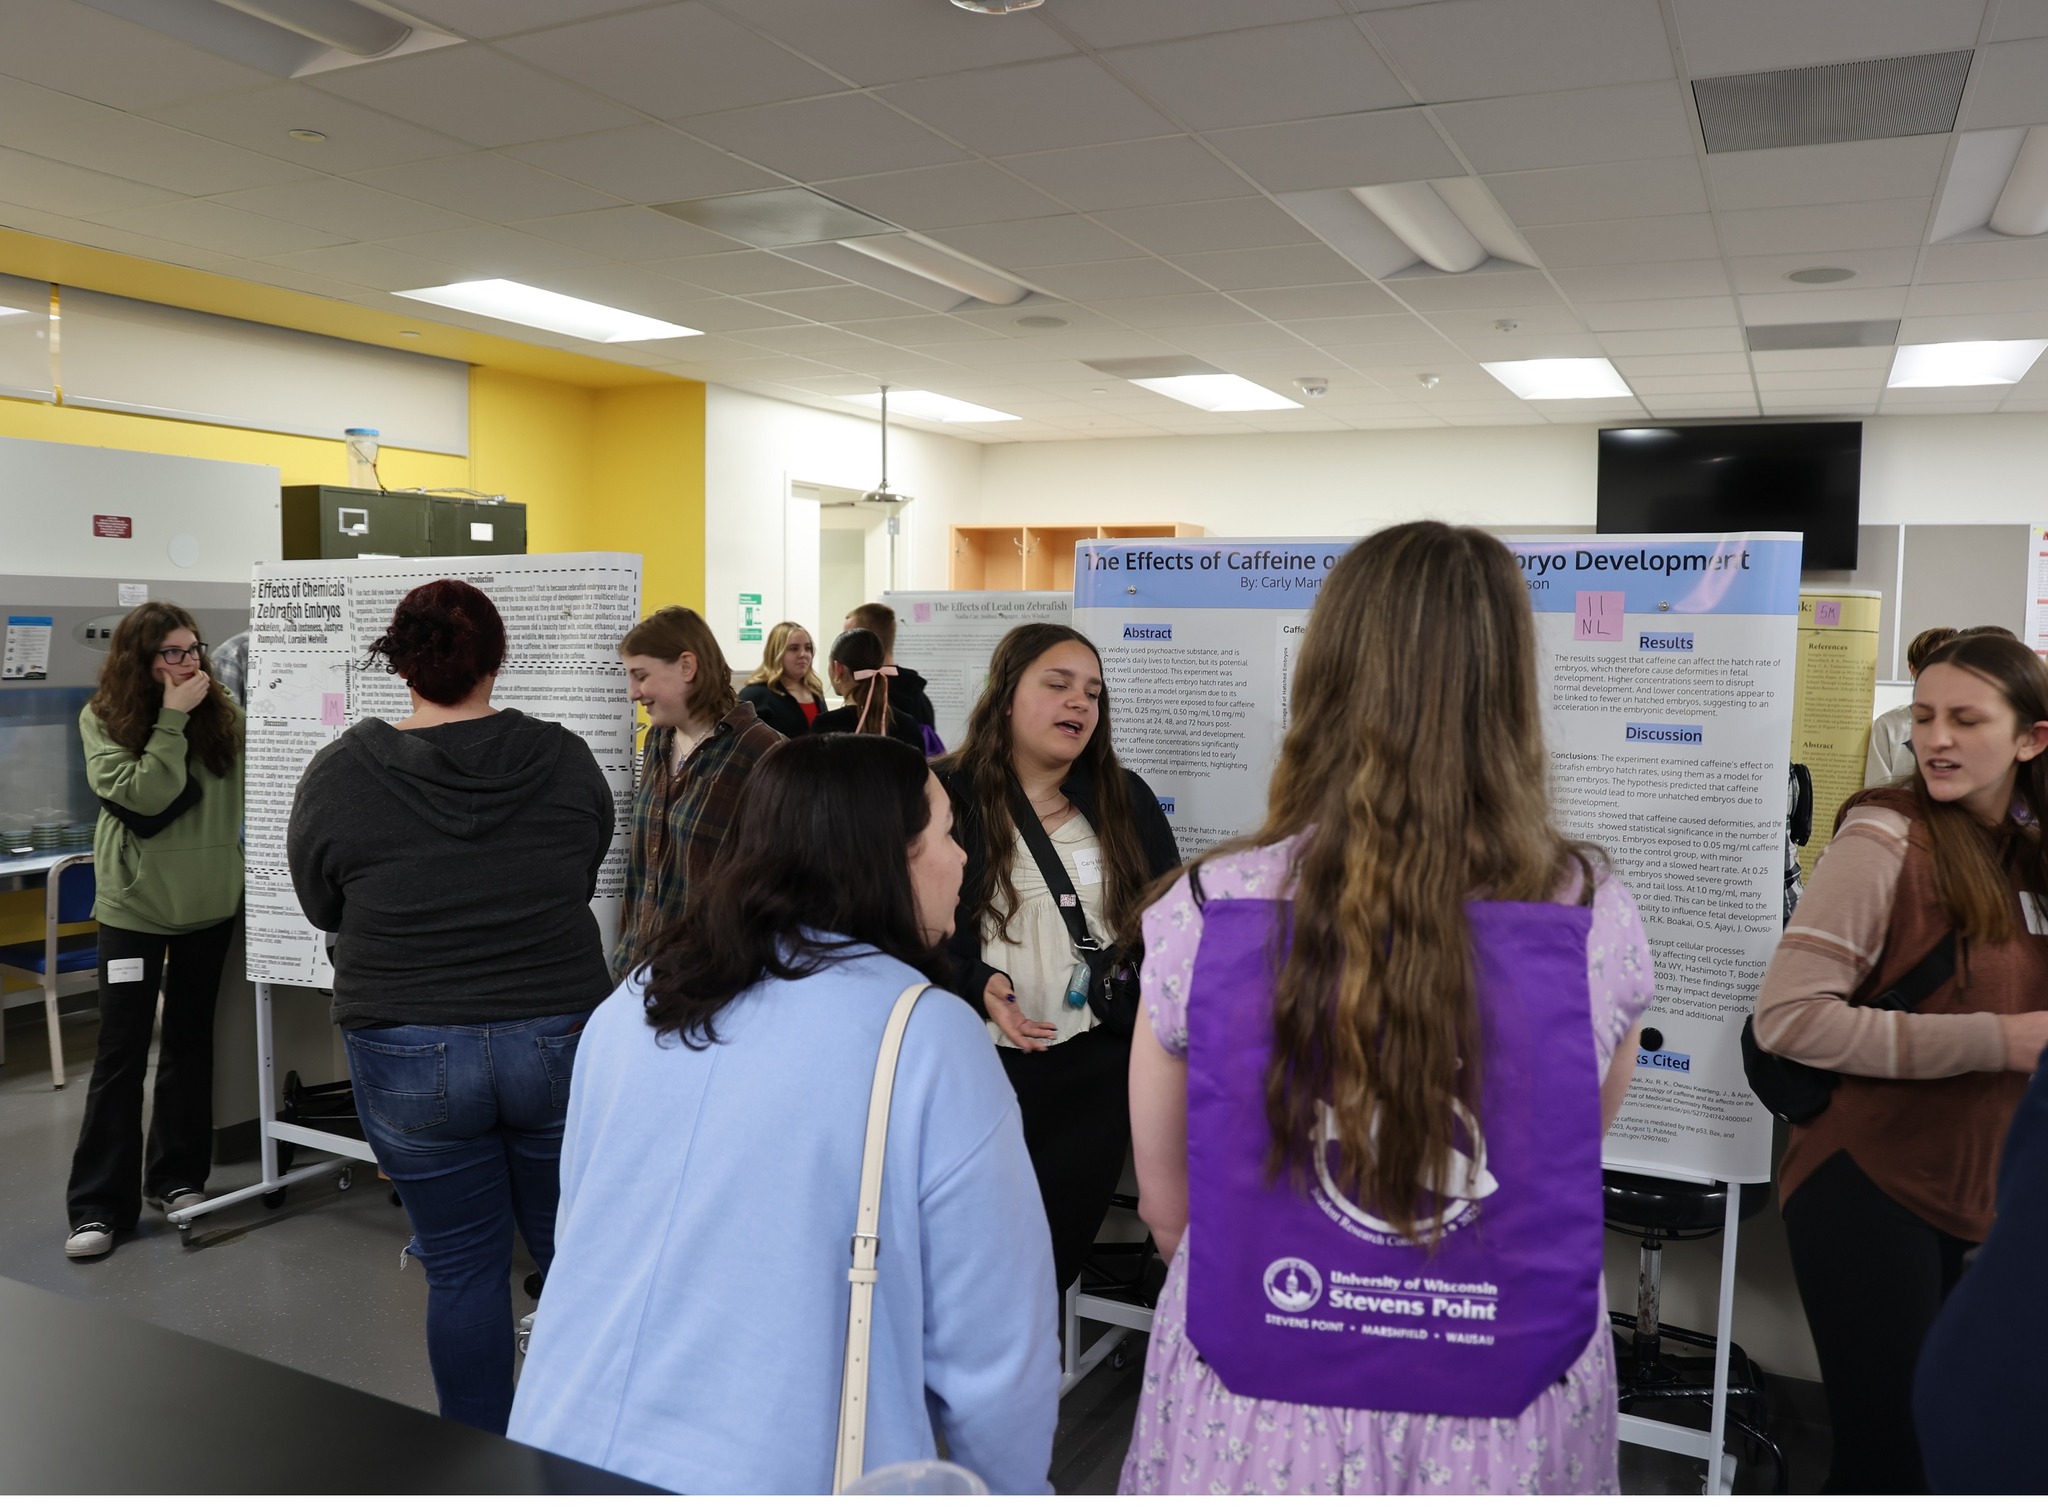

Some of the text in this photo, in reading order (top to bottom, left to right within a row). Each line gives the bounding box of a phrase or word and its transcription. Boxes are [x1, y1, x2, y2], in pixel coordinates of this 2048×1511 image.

[1085, 550, 1750, 576] The Effects of Caffeine o bryo Development
[258, 582, 290, 598] Effects
[291, 582, 301, 598] of
[302, 580, 345, 598] Chemicals
[618, 584, 628, 592] the
[1241, 576, 1258, 589] By:
[1261, 575, 1292, 591] Carly
[257, 602, 302, 619] Zebrafish
[304, 602, 341, 621] Embryos
[617, 603, 629, 611] that
[934, 602, 949, 612] The
[951, 602, 979, 612] Effects
[980, 602, 990, 612] of
[992, 602, 1012, 612] Lead
[1014, 604, 1025, 612] on
[1026, 600, 1068, 612] Zebrafish
[595, 612, 620, 621] pollution
[1123, 626, 1173, 641] Abstract
[1639, 636, 1694, 650] Results
[1808, 642, 1848, 651] References
[1555, 653, 1569, 662] The
[1570, 654, 1595, 662] results
[1598, 656, 1627, 665] suggest
[1629, 655, 1644, 663] that
[1646, 656, 1676, 664] caffeine
[1693, 656, 1715, 665] affect
[1717, 657, 1729, 665] the
[1731, 657, 1754, 666] hatch
[1773, 658, 1781, 666] of
[1555, 663, 1589, 674] embryos,
[1591, 664, 1613, 673] which
[1615, 665, 1650, 674] therefore
[1675, 666, 1719, 675] deformities
[1721, 667, 1728, 676] in
[1730, 668, 1748, 676] fetal
[1554, 673, 1606, 684] development.
[1608, 674, 1633, 685] Higher
[1635, 676, 1691, 685] concentrations
[1716, 678, 1724, 686] to
[1726, 678, 1754, 689] disrupt
[1554, 683, 1775, 699] normal development. And lower concentrations appear to
[1554, 692, 1563, 700] be
[1565, 692, 1588, 701] linked
[1590, 694, 1598, 702] to
[1600, 694, 1621, 702] fewer
[1634, 695, 1665, 704] hatched
[1666, 696, 1701, 707] embryos,
[1703, 699, 1747, 709] suggesting
[1553, 703, 1718, 718] acceleration in the embryonic development.
[1625, 727, 1703, 743] Discussion
[1803, 742, 1834, 750] Abstract
[1551, 750, 1598, 761] Conclusions:
[1601, 753, 1614, 762] The
[1616, 755, 1659, 764] experiment
[1661, 757, 1699, 766] examined
[1700, 759, 1738, 768] caffeine's
[1740, 760, 1762, 769] effect
[1586, 832, 1620, 843] embryos.
[1623, 834, 1656, 846] Embryos
[1658, 838, 1691, 847] exposed
[1703, 839, 1721, 848] 0.05
[1723, 842, 1750, 852] mg/ml
[1752, 843, 1779, 852] caffeine
[1647, 936, 1745, 956] disrupt cellular processes
[1652, 1054, 1690, 1071] Cited
[1330, 1270, 1498, 1295] University of Wisconsin
[1328, 1289, 1497, 1320] Stevens Point
[1265, 1314, 1310, 1330] STEVENS
[1311, 1319, 1345, 1332] POINT
[1445, 1332, 1495, 1346] WAUSAU
